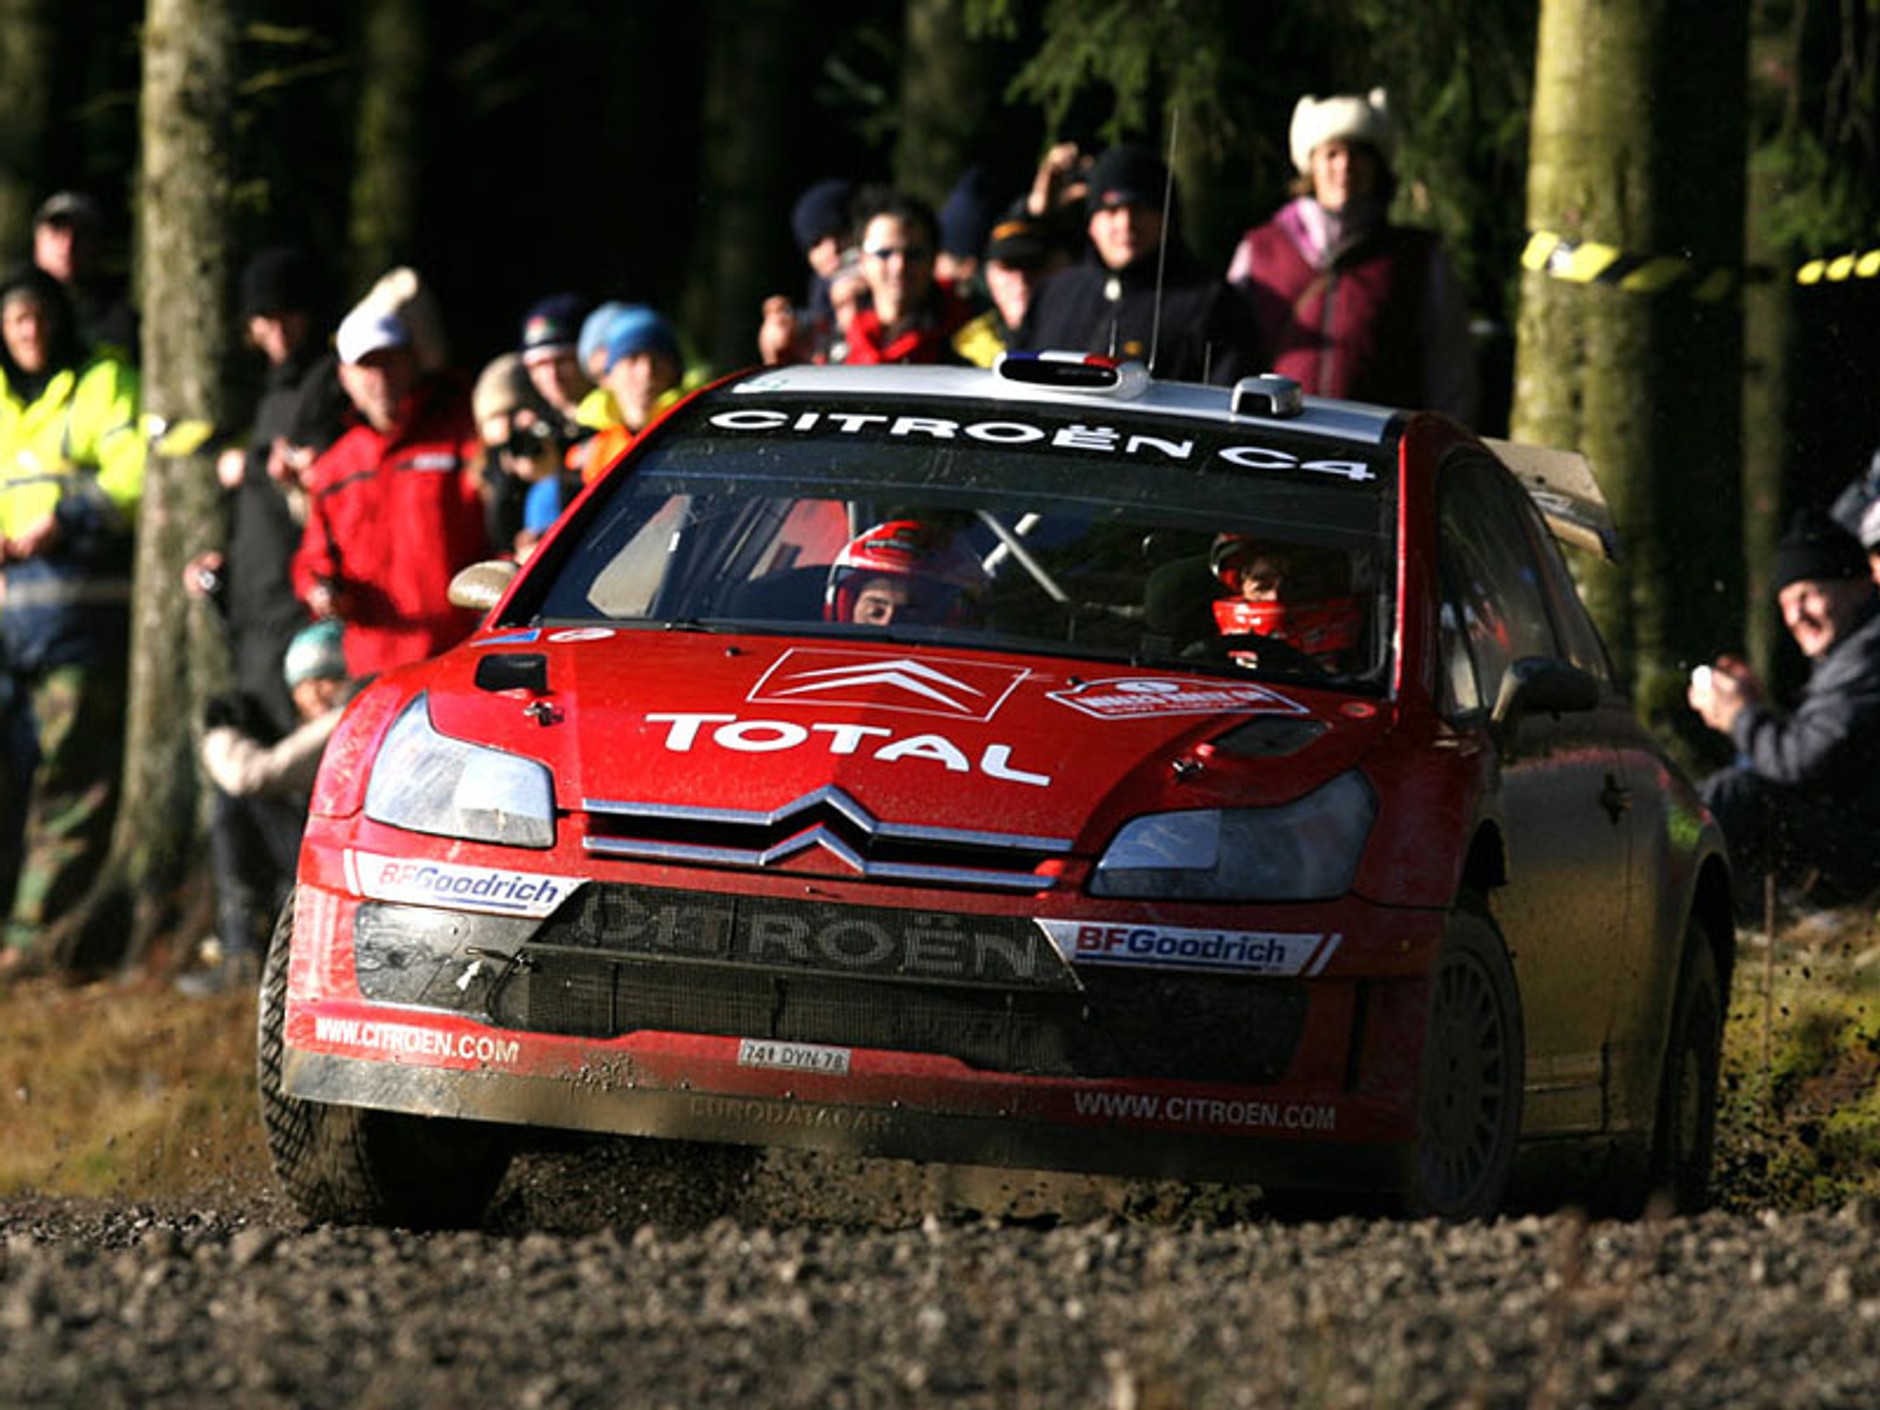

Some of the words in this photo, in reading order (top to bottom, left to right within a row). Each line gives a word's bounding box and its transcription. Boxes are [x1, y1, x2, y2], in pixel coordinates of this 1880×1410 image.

[709, 410, 1193, 459] CITROËN
[1218, 446, 1377, 482] C4
[645, 713, 1051, 787] TOTAL
[378, 861, 561, 905] BFGoodrich
[1075, 925, 1286, 964] BFGoodrich
[314, 1016, 520, 1063] WWW.CITROEN.COM
[781, 1046, 819, 1067] DYN
[1074, 1090, 1337, 1131] WWW.CITROEN.COM
